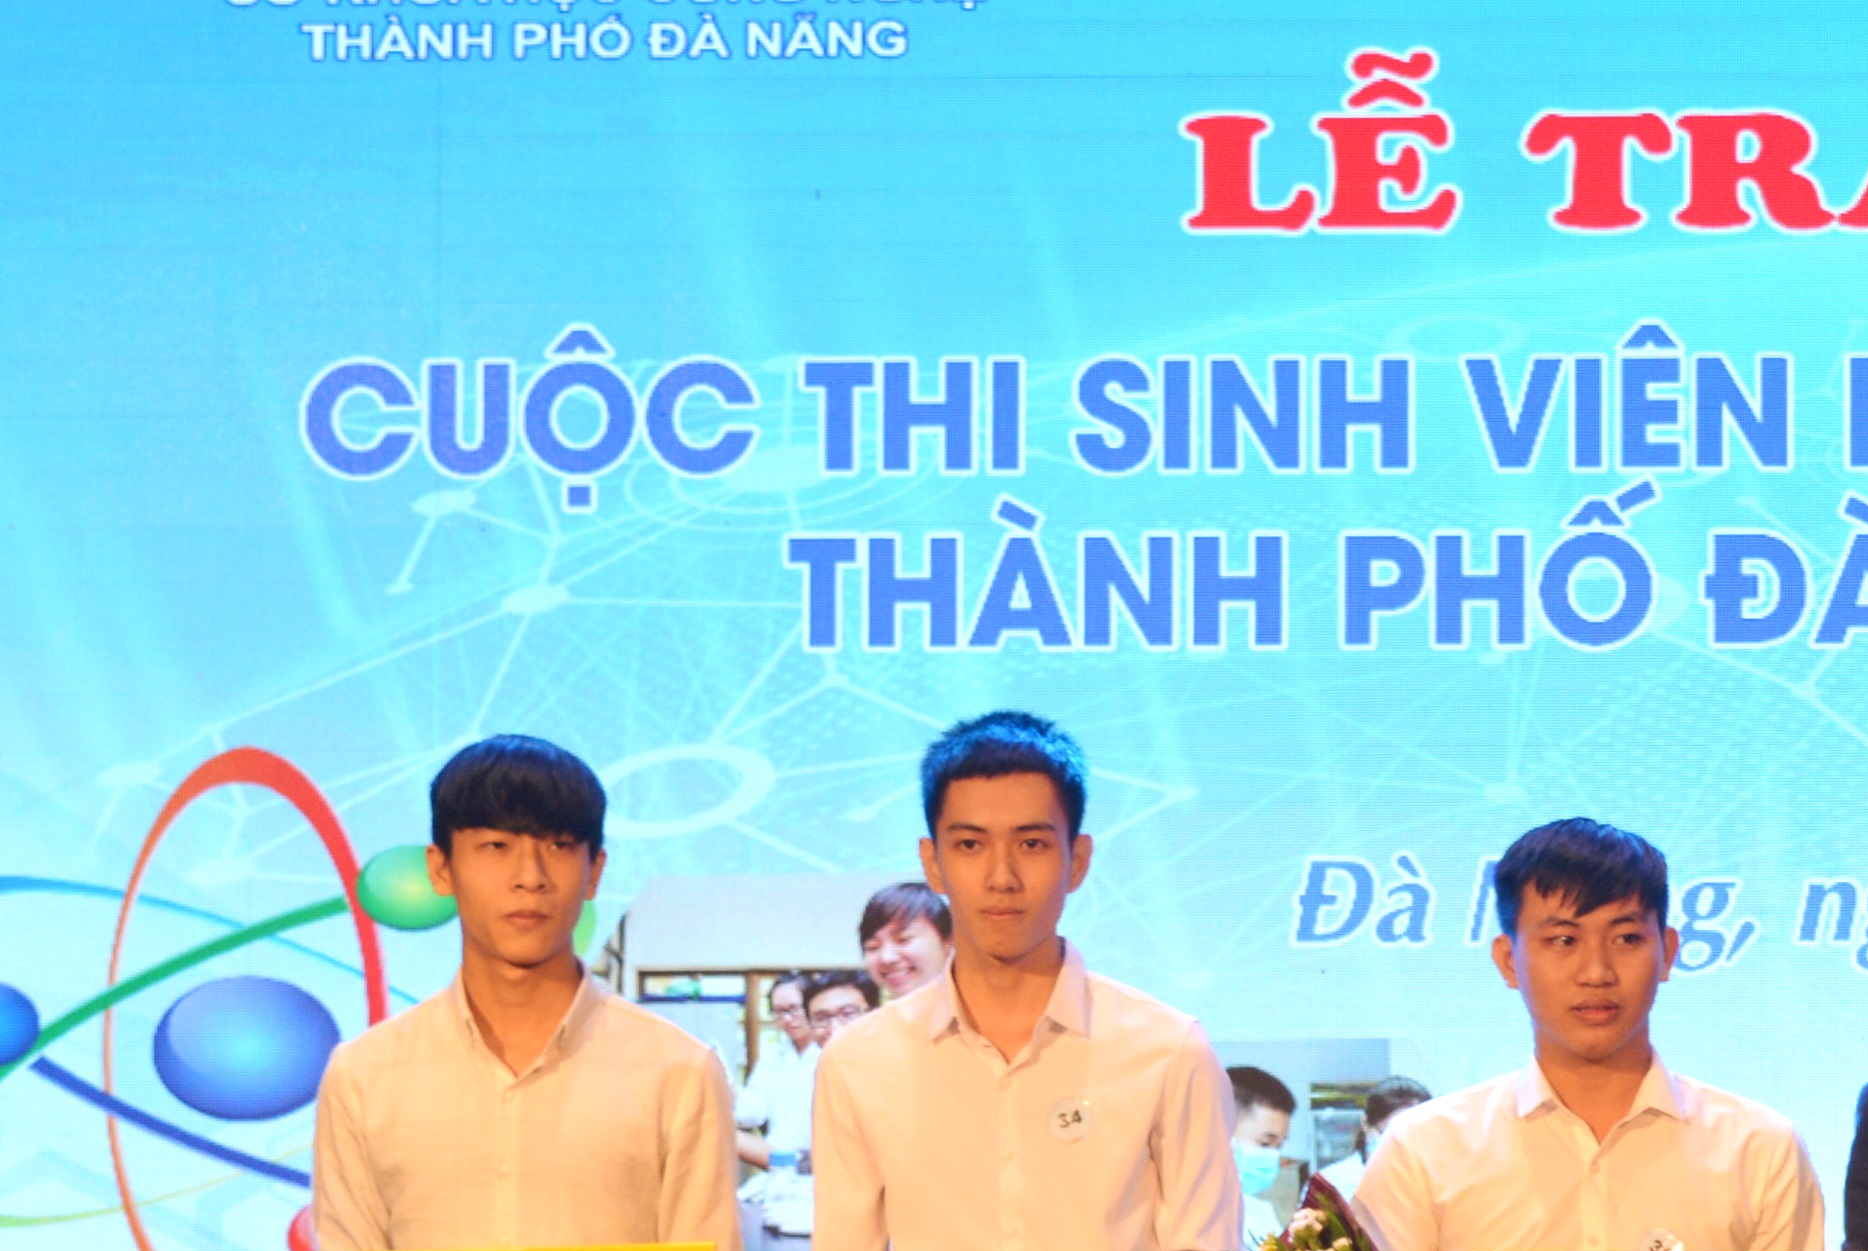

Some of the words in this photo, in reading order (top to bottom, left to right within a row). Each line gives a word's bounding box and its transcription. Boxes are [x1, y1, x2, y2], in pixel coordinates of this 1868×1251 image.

[301, 14, 492, 58] THÀNH
[514, 13, 631, 58] PHỐ
[647, 12, 728, 57] ĐÀ
[1184, 52, 1456, 230] LỄ
[306, 328, 757, 510] CUỘC
[803, 360, 1022, 472] THI
[1074, 358, 1410, 473] SINH
[1465, 323, 1789, 470] VIÊN
[788, 500, 1283, 649] THÀNH
[1344, 480, 1657, 648] PHỐ
[1296, 855, 1431, 944] Đà
[1058, 1109, 1082, 1128] 34
